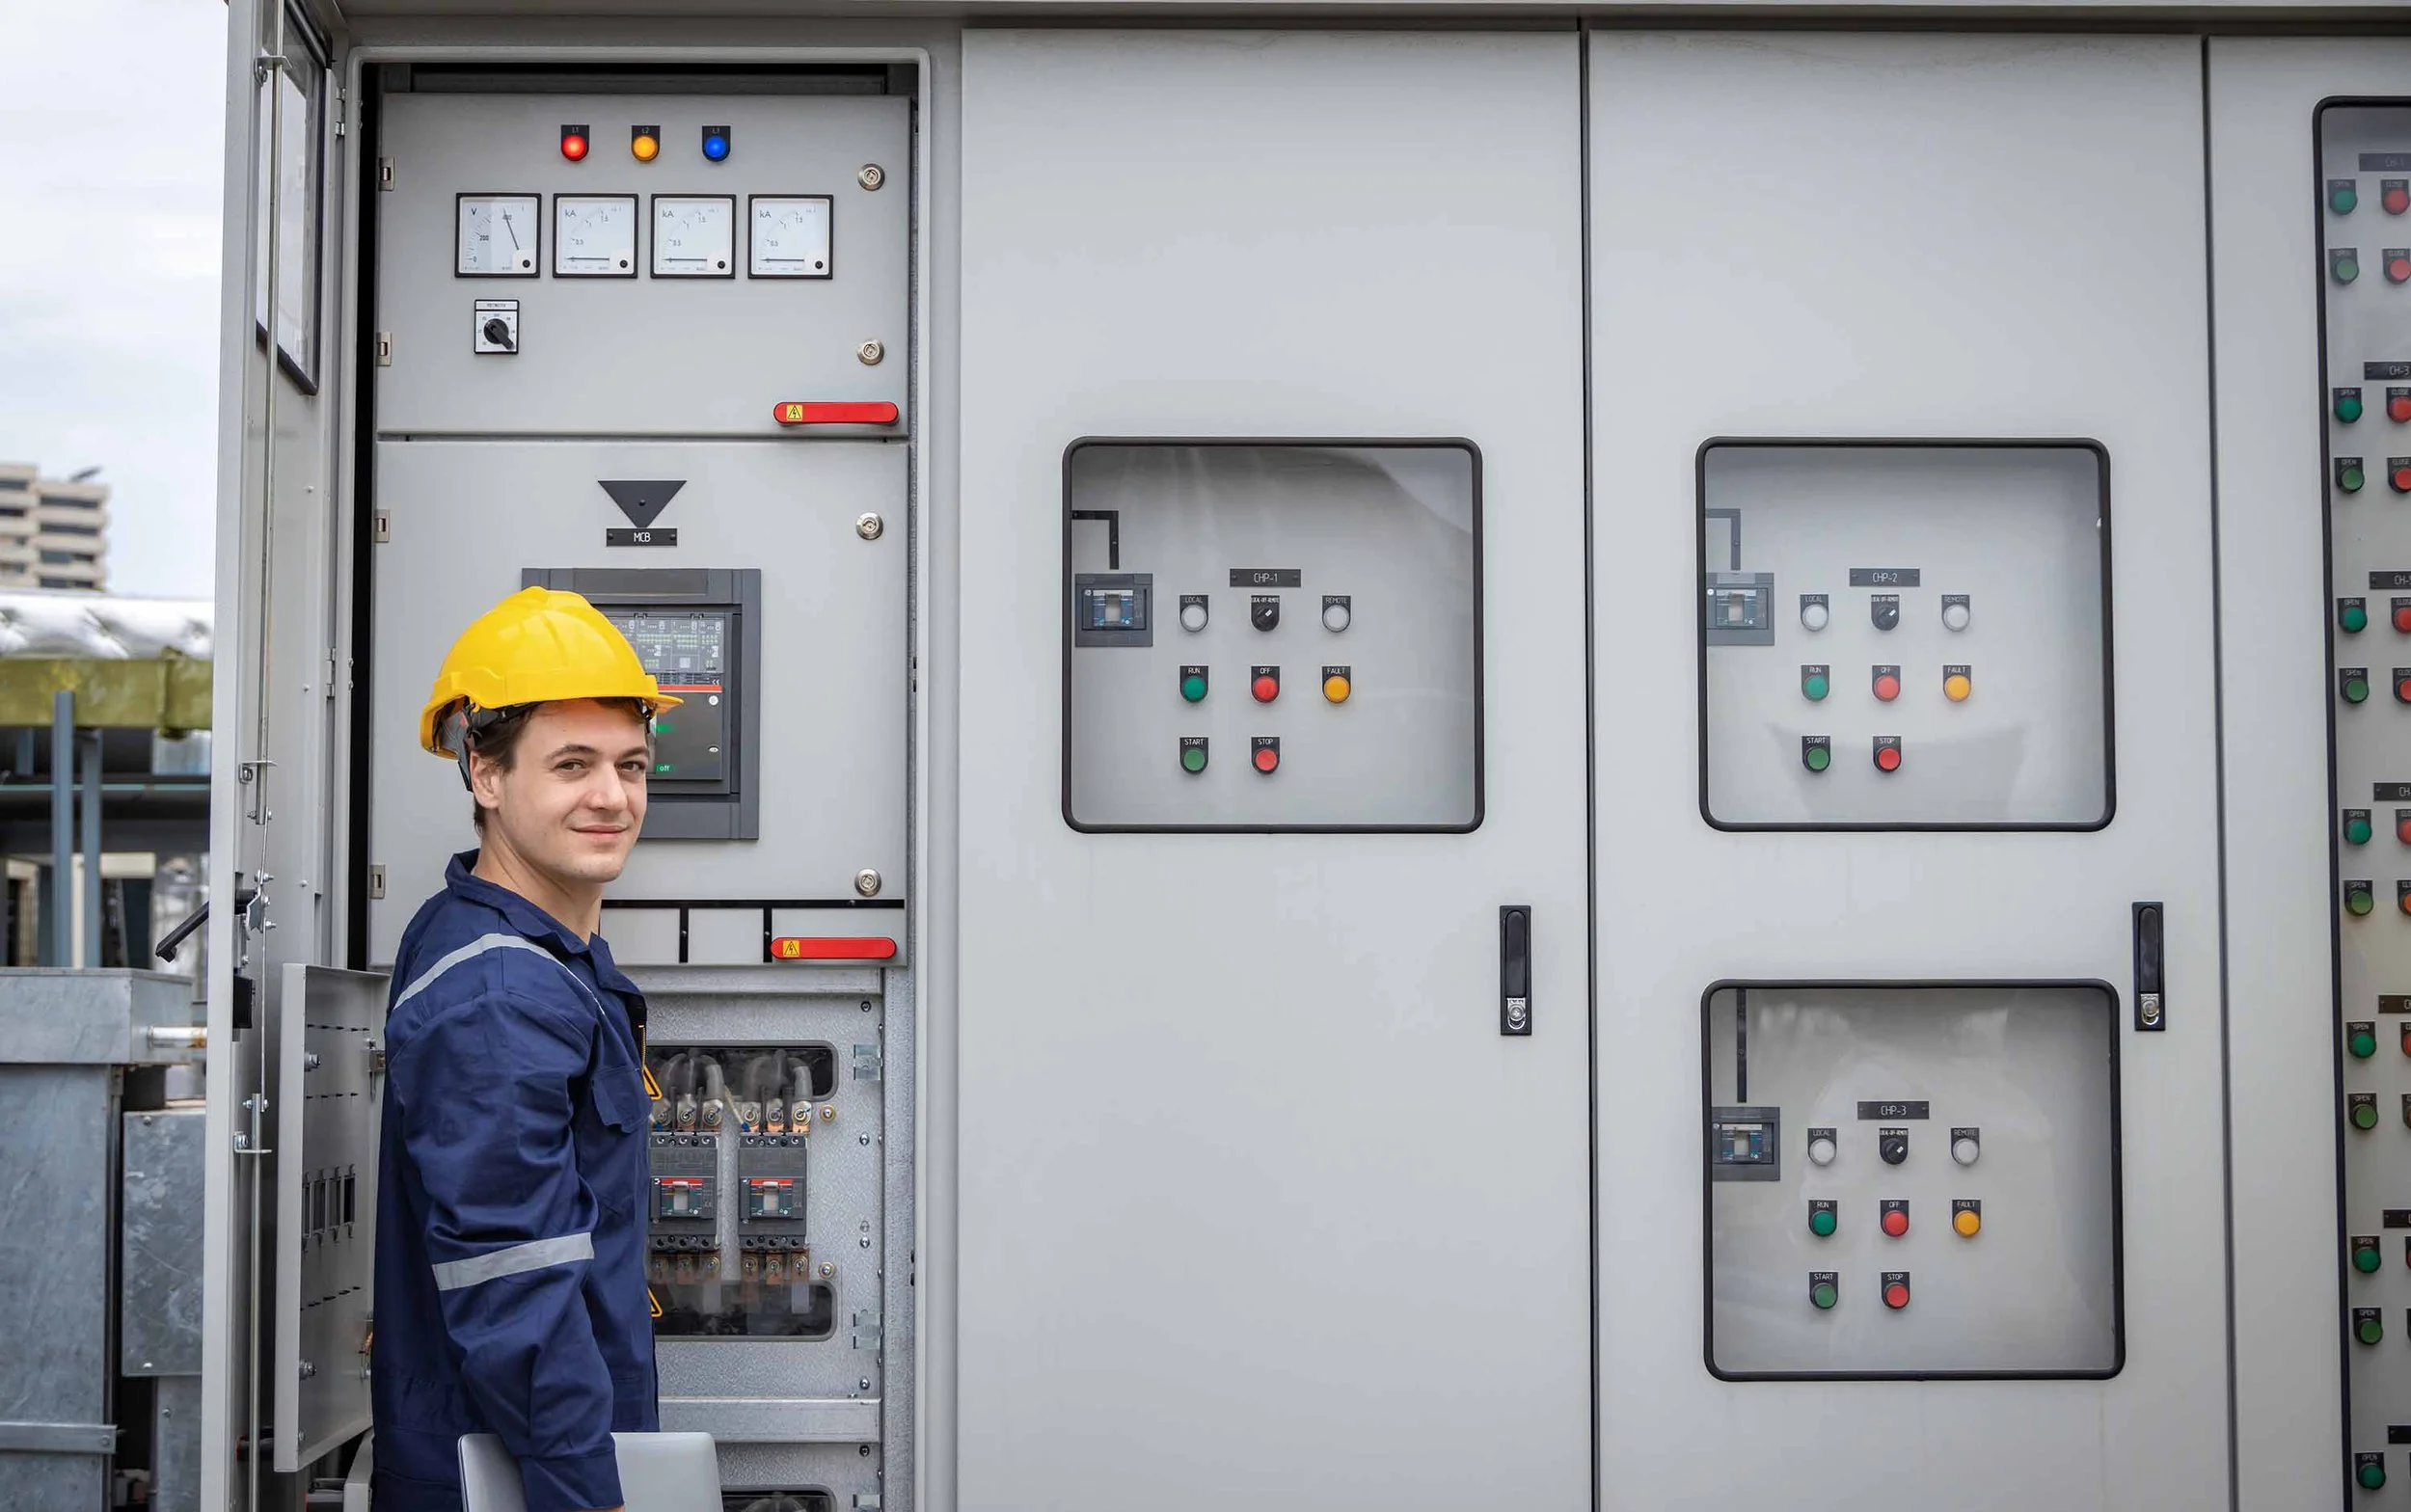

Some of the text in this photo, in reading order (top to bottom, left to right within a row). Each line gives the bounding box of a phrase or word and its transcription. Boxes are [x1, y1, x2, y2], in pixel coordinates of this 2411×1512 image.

[471, 207, 477, 216] V
[662, 209, 674, 218] kA
[759, 210, 772, 219] kA
[2389, 365, 2410, 376] CH-3
[633, 531, 651, 542] MCB
[1254, 573, 1278, 583] CHP-1
[1872, 573, 1898, 583] CHP-2
[660, 764, 670, 772] off
[1881, 1105, 1907, 1116] CHP-3
